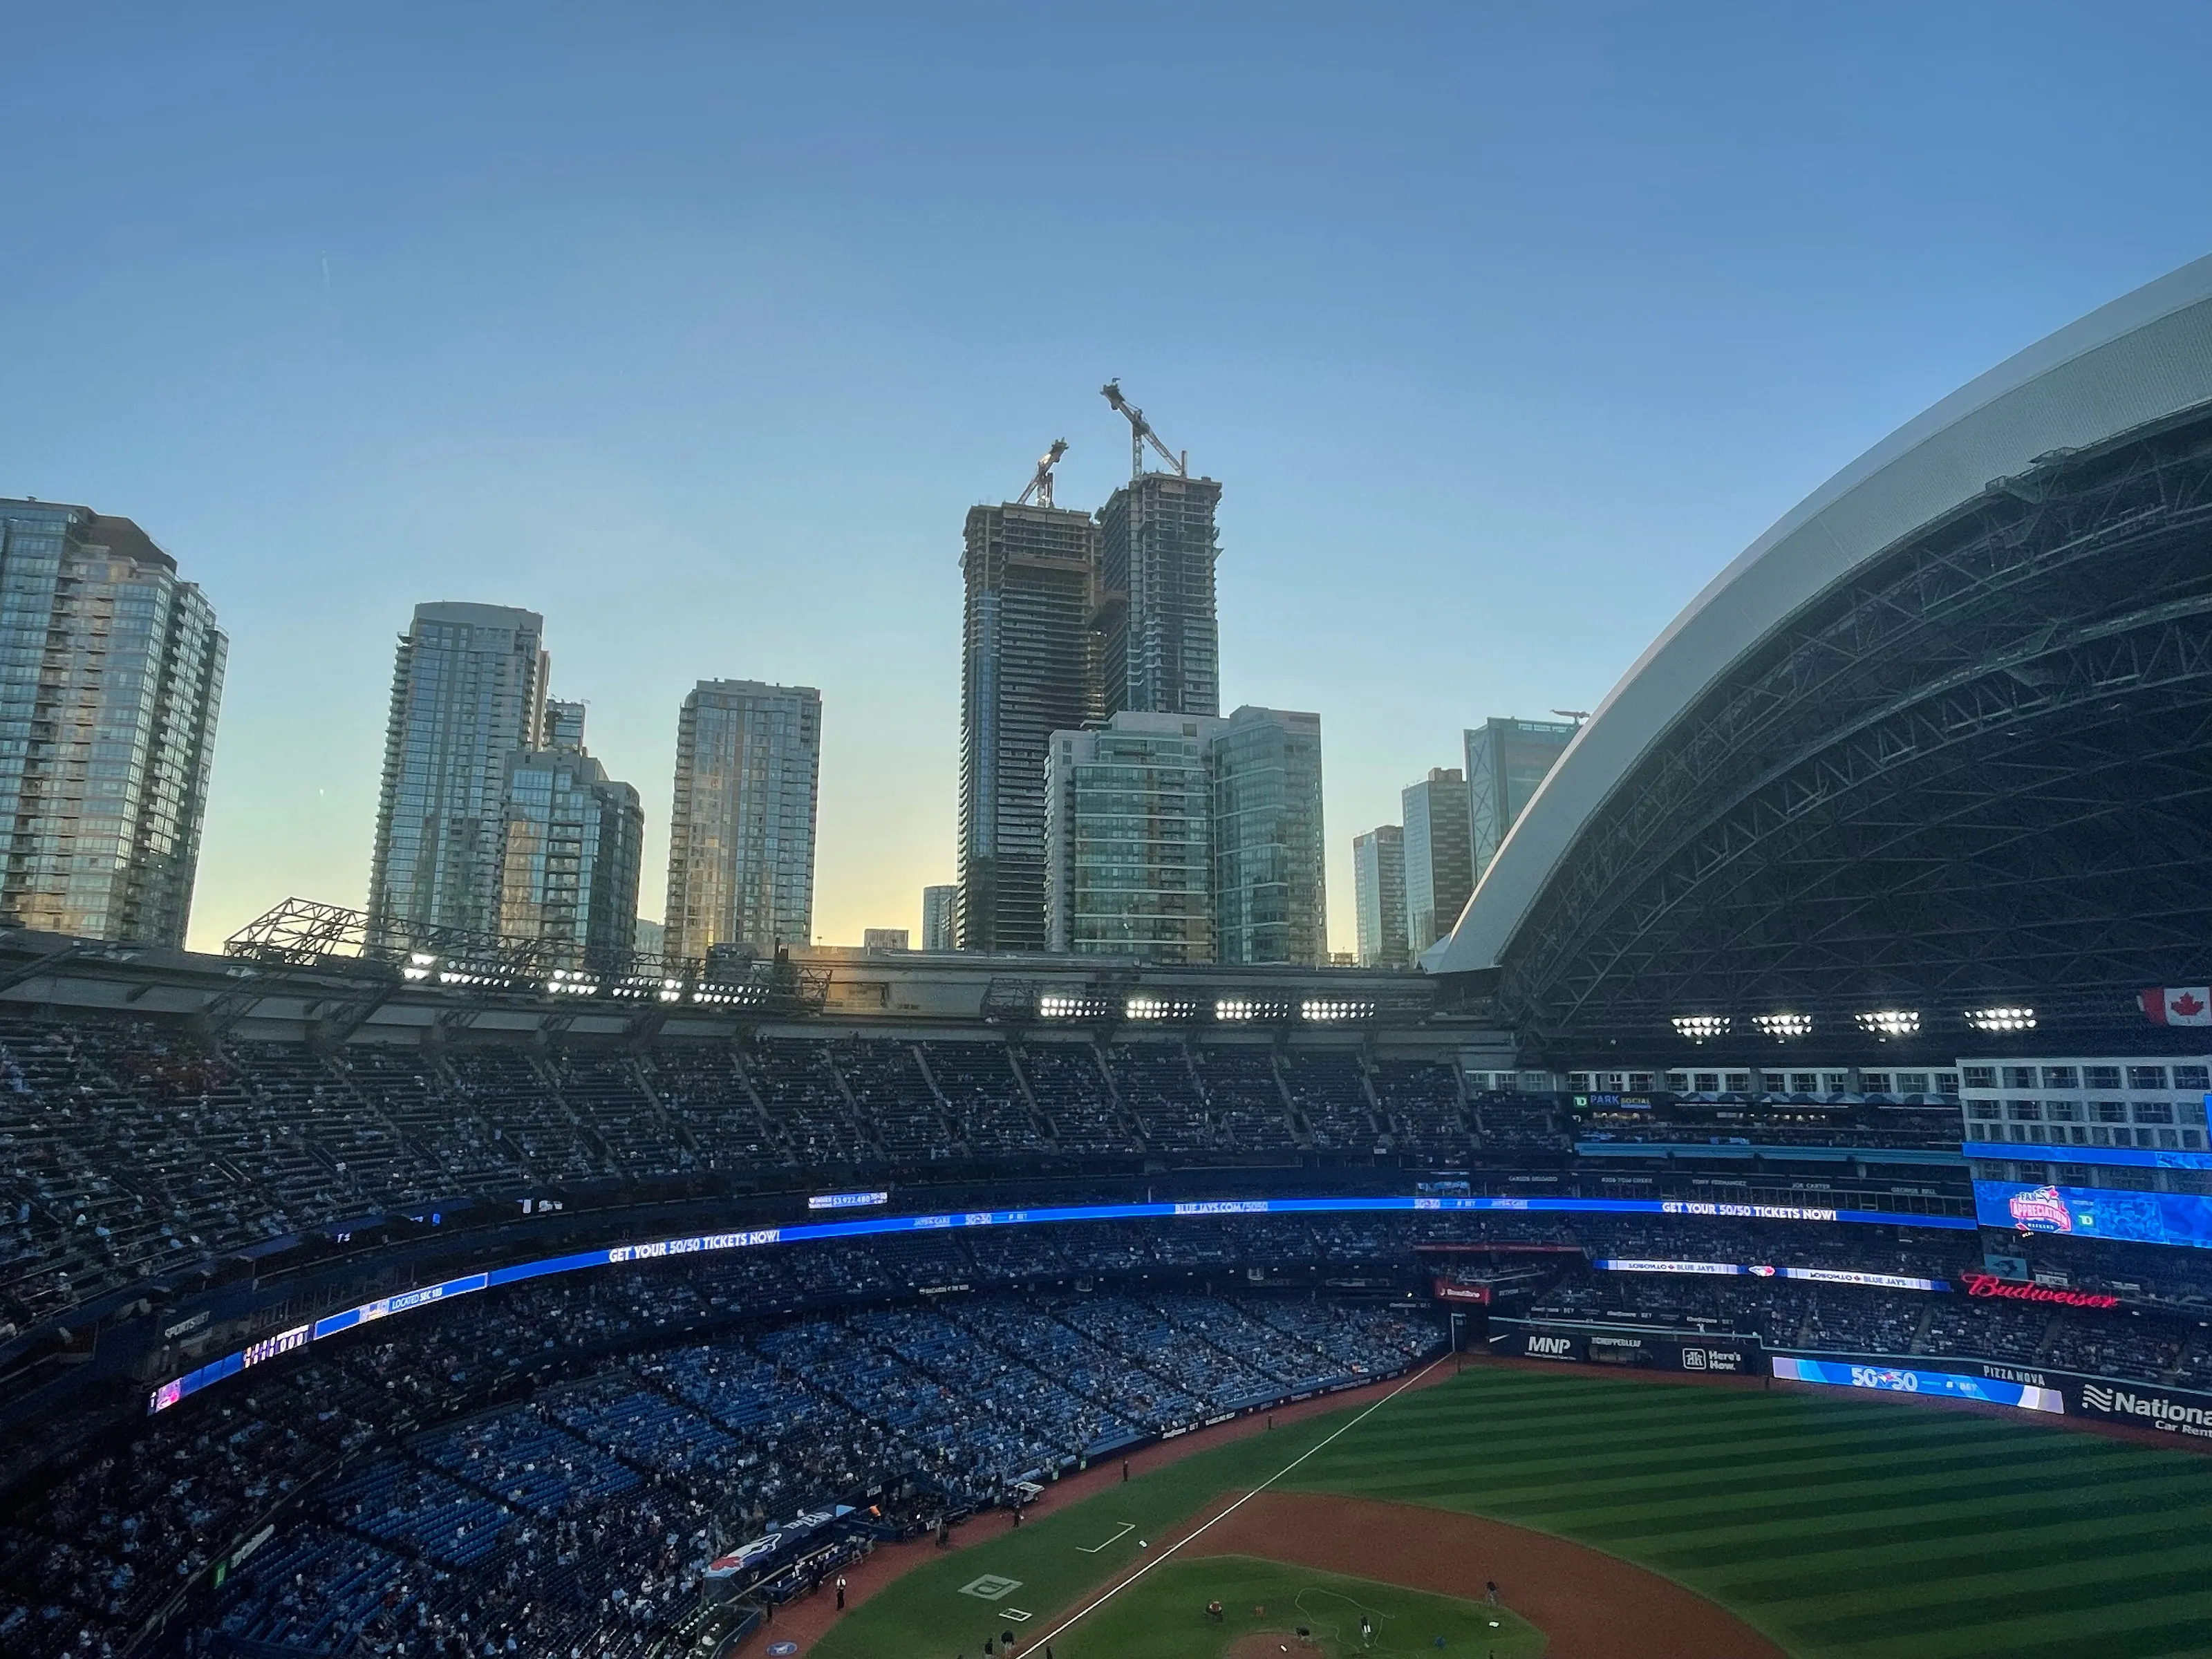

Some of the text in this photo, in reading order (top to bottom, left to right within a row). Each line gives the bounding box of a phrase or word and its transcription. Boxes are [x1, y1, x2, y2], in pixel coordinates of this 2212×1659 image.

[1575, 1097, 1587, 1106] TD
[1591, 1095, 1619, 1105] PARK
[2021, 1192, 2037, 1201] FAN
[1662, 1201, 1837, 1221] GET YOUR 50/50 TICKETS NOW!
[2013, 1202, 2068, 1227] APPRECIATION
[2079, 1215, 2093, 1225] TD
[609, 1230, 780, 1263] GET YOUR 50/50 TICKETS NOW!
[1962, 1273, 2118, 1308] Budweiser
[392, 1293, 419, 1310] LOCATED
[420, 1290, 433, 1302] SEC
[1528, 1336, 1571, 1354] MNP
[1709, 1350, 1741, 1361] Here's
[1709, 1361, 1736, 1371] How.
[1983, 1365, 2045, 1387] PIZZA NOVA
[2155, 1420, 2177, 1432] Car
